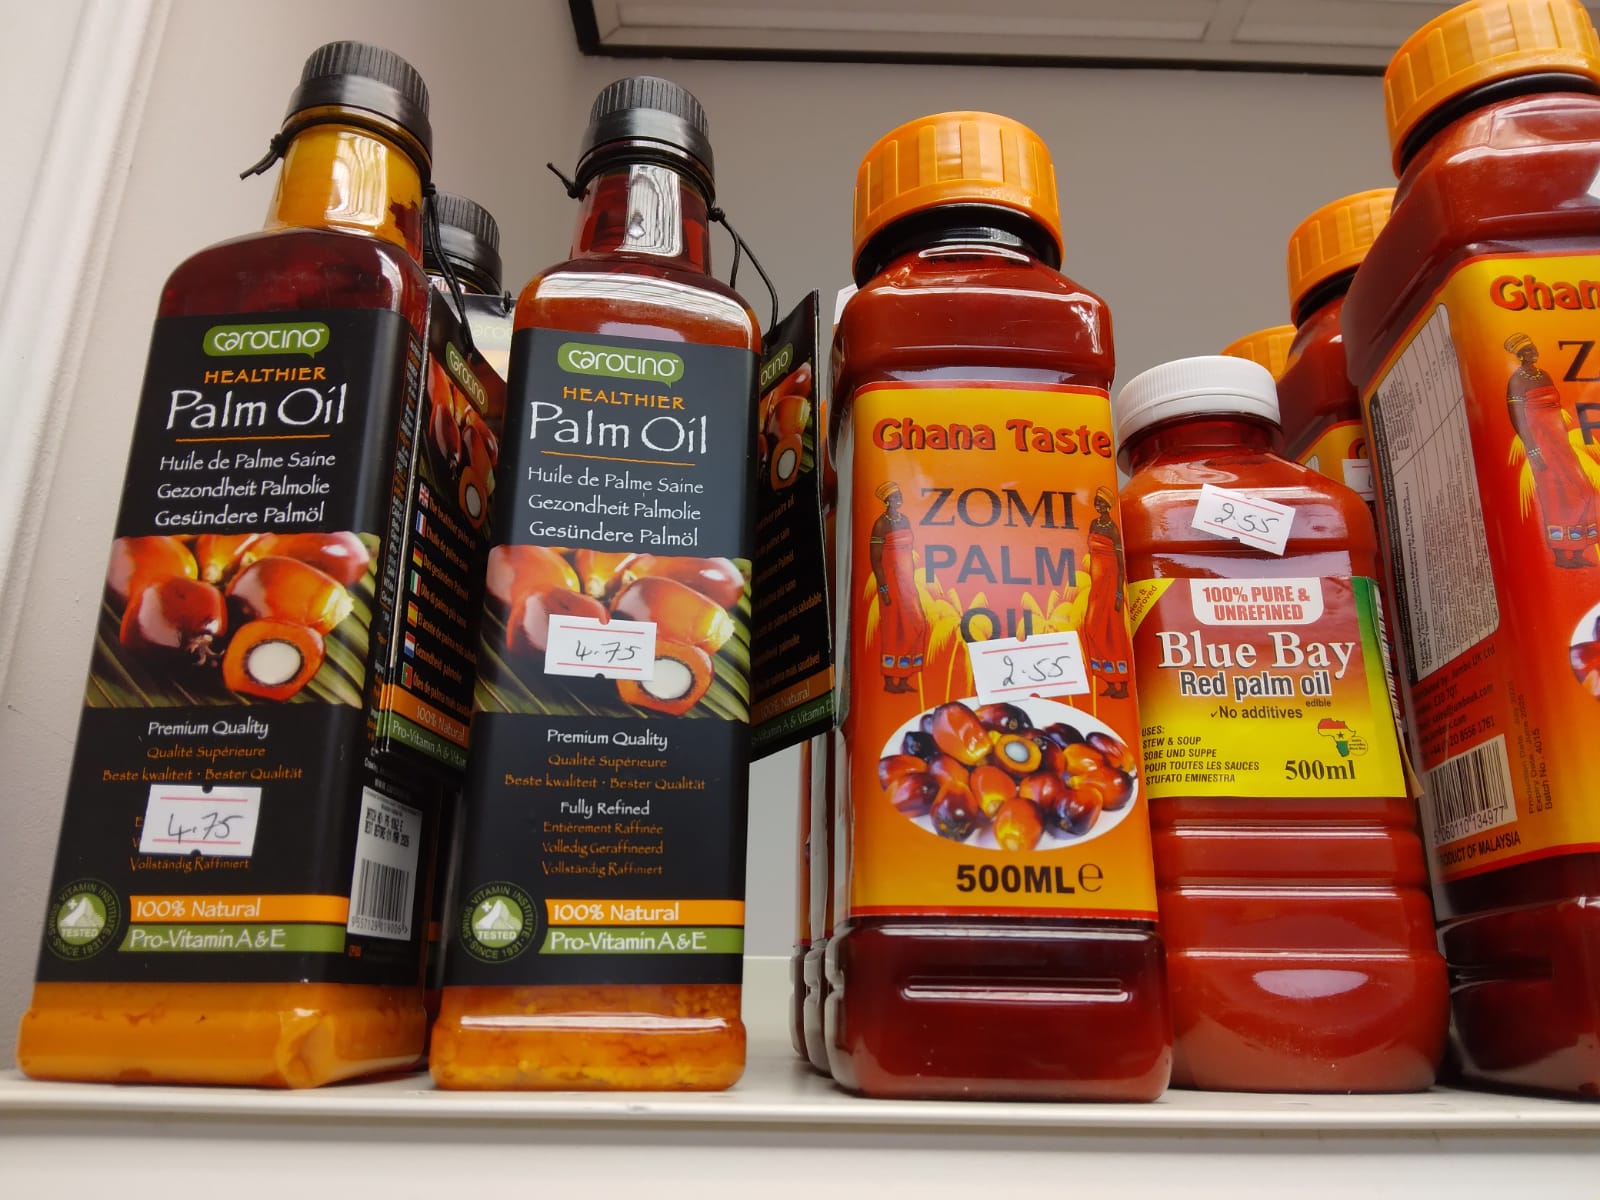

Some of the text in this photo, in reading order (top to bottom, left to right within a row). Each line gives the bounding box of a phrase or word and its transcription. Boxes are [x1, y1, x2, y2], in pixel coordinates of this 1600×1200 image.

[214, 328, 324, 351] carotino
[569, 348, 677, 377] carotino
[204, 367, 327, 385] HEALTHIER
[166, 383, 348, 430] Palm Oil
[563, 386, 685, 410] HEALTHIER
[530, 401, 707, 455] Palm Oil
[872, 417, 1113, 459] Ghana Taste
[159, 449, 336, 471] Huile de Palme Saine
[157, 474, 330, 499] Gezondheit Palmolie
[528, 464, 704, 494] Huile de Palme Saine
[155, 502, 324, 527] Gesündere Palmöl
[528, 494, 702, 520] Gezondheit Palmolie
[919, 487, 1079, 530] ZOMI
[1214, 502, 1279, 534] 2.55
[529, 521, 699, 547] Gesündere Palmöl
[923, 543, 1077, 588] PALM
[1130, 585, 1158, 622] Improved
[1203, 586, 1310, 603] 100% PURE &
[1214, 603, 1304, 621] UNREFINED
[576, 640, 640, 663] 4.75
[1156, 630, 1355, 680] Blue Bay
[1002, 654, 1070, 687] 2.55
[1179, 670, 1332, 702] Red palm oil
[1219, 705, 1303, 719] No additives
[1305, 699, 1332, 708] edible
[148, 716, 269, 740] Premium Quality
[547, 729, 668, 751] Premium Quality
[1142, 736, 1201, 749] STEW & SOUP
[548, 752, 596, 767] Qualité
[1166, 749, 1186, 758] UND
[1189, 748, 1217, 758] SUPPE
[102, 768, 139, 781] Beste
[142, 767, 193, 781] kwaliteit
[205, 768, 247, 780] Bester
[1144, 761, 1260, 773] POUR TOUTES LES SAUCES
[1285, 759, 1356, 780] 500ml
[504, 773, 542, 787] Beste
[545, 773, 597, 789] kwaliteit
[609, 776, 651, 790] Bester
[1145, 774, 1182, 786] STUFATO
[560, 799, 650, 819] Fully Refined
[167, 811, 245, 844] 4.75
[589, 839, 664, 855] Geraffineerd
[1467, 843, 1477, 859] OF
[1479, 830, 1521, 856] MALAYSIA
[956, 863, 1075, 894] 500ML
[471, 886, 511, 905] VITAMIN
[136, 898, 261, 918] 100% Natural
[554, 902, 679, 921] 100% Natural
[60, 927, 98, 938] TESTED
[130, 926, 235, 950] Pro-Vitamin
[477, 930, 518, 940] TESTED
[550, 931, 655, 951] Pro-Vitamin
